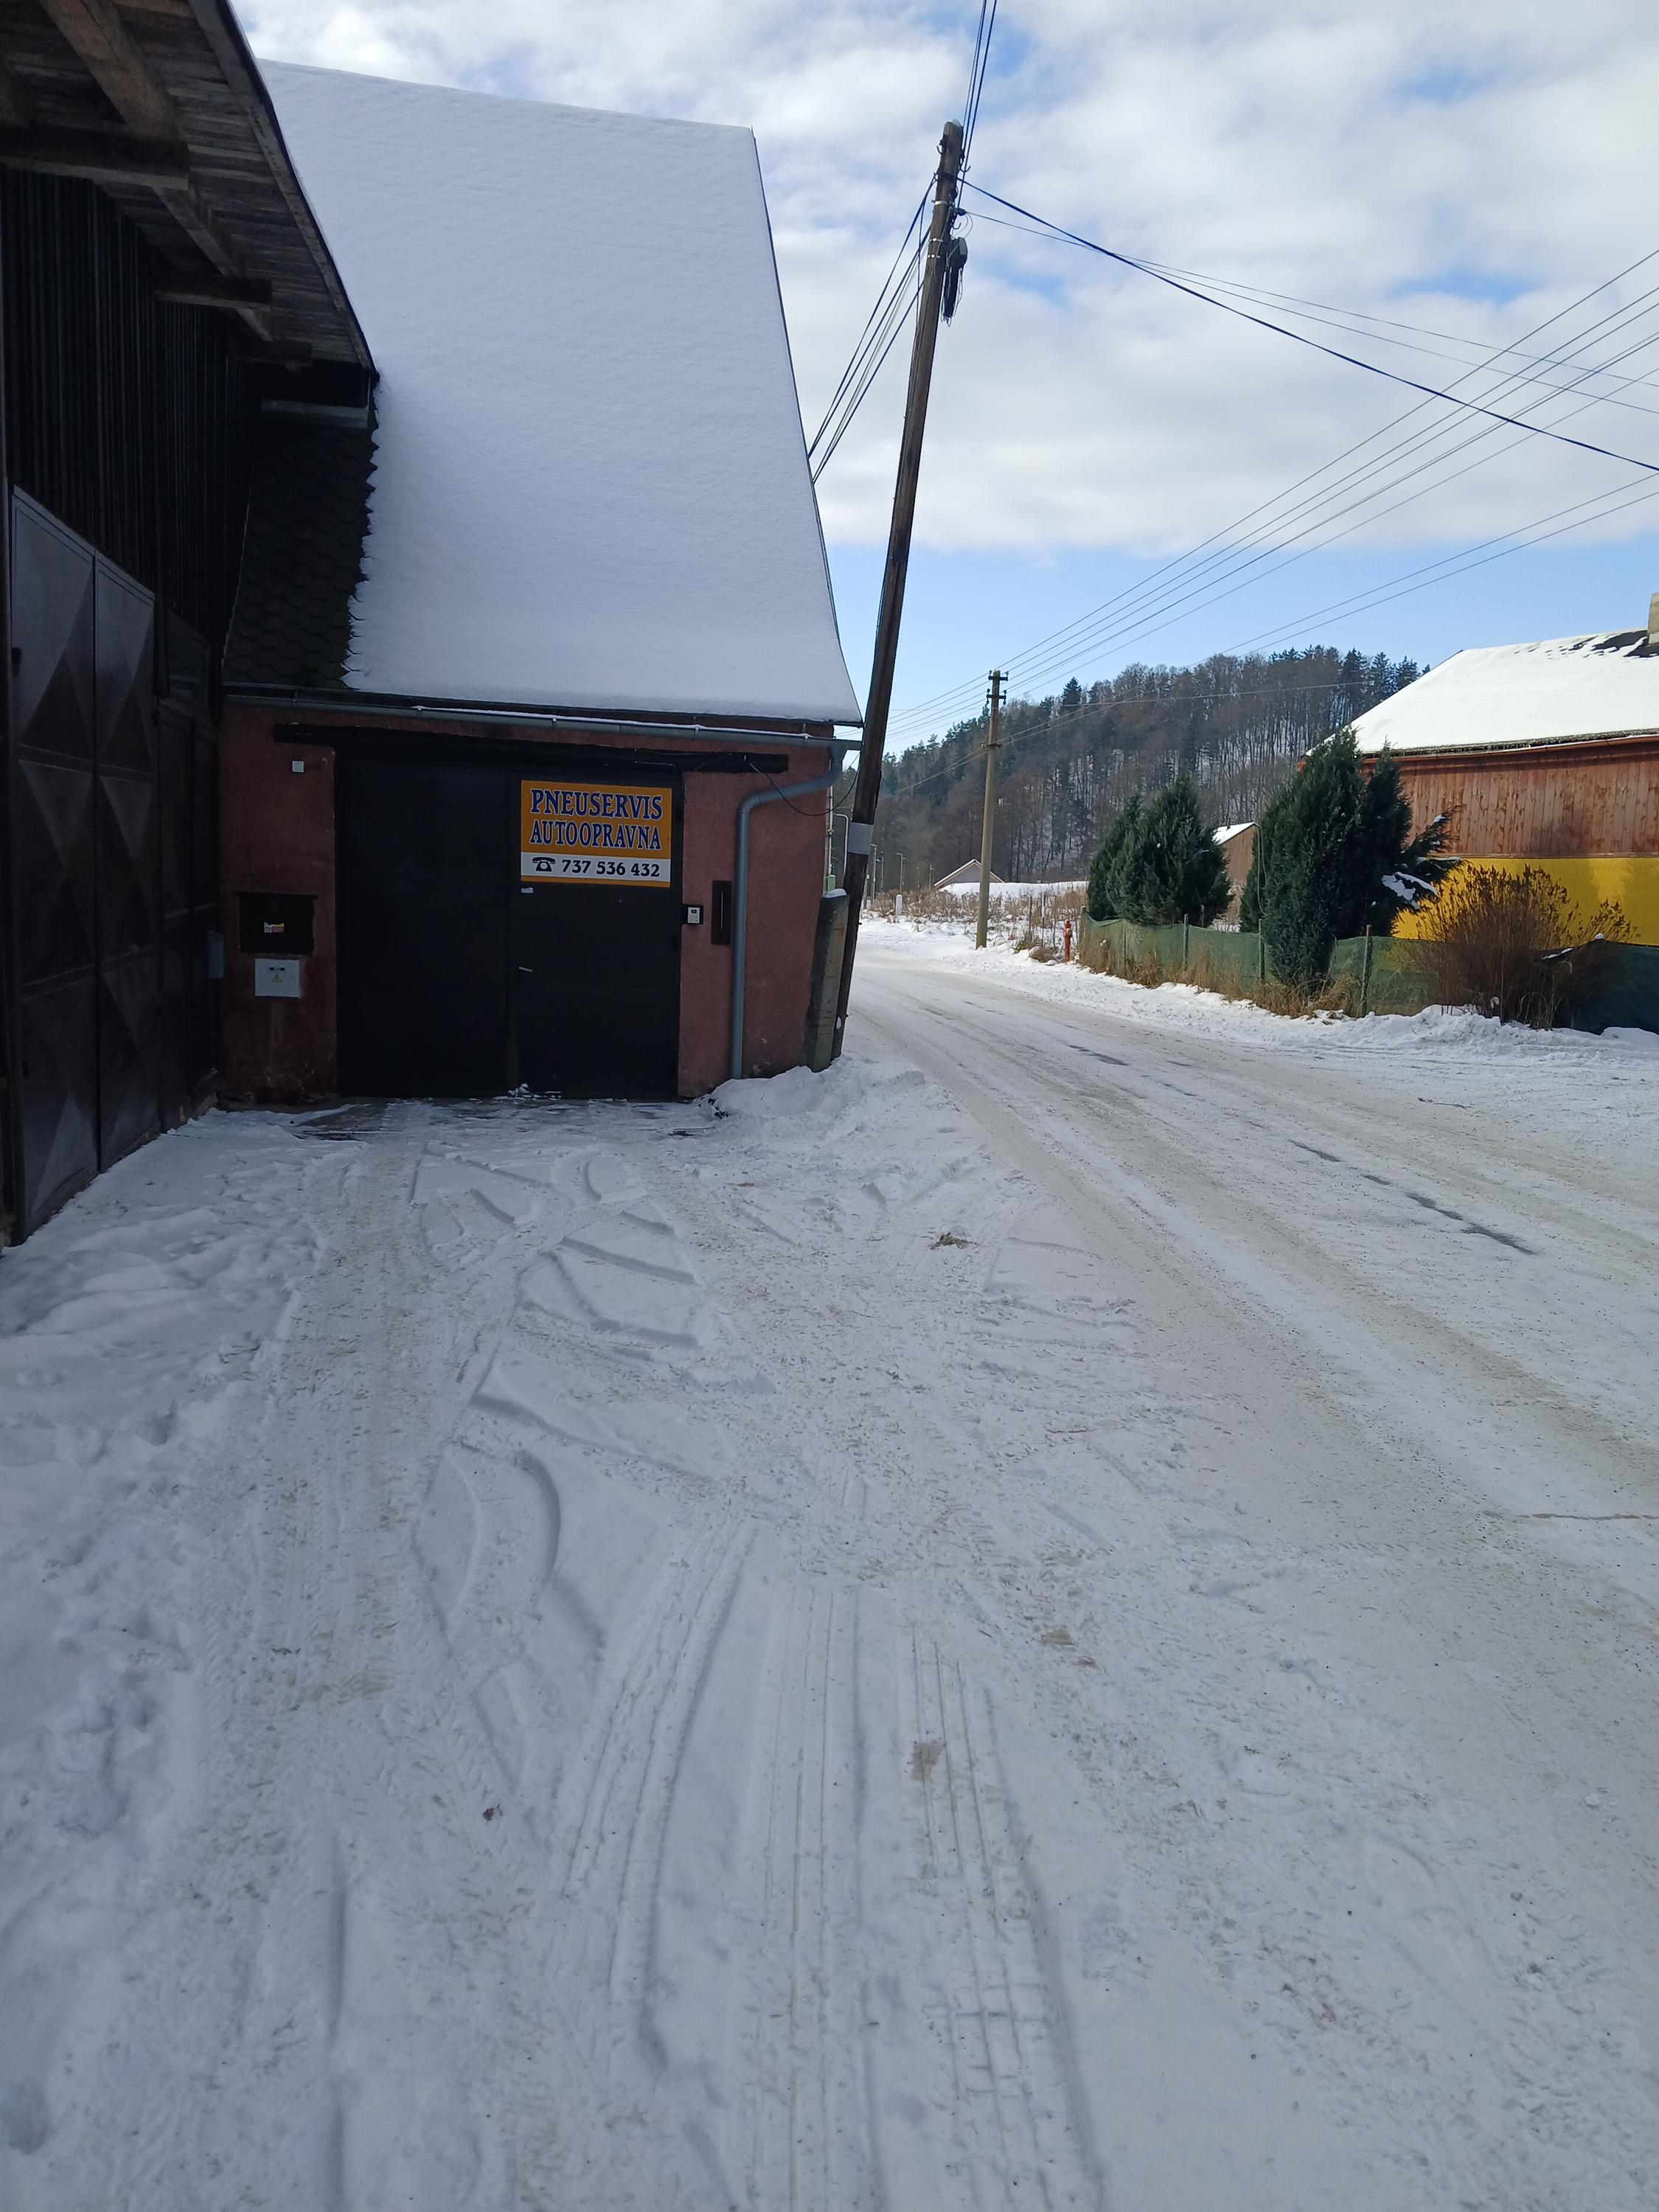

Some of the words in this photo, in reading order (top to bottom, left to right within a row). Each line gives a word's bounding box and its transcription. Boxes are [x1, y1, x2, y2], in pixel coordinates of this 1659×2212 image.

[531, 788, 663, 820] PNEUSERVIS
[529, 819, 661, 850] AUTOOPRAVNA
[562, 859, 591, 874] 737
[596, 861, 626, 875] 536
[630, 863, 660, 877] 432
